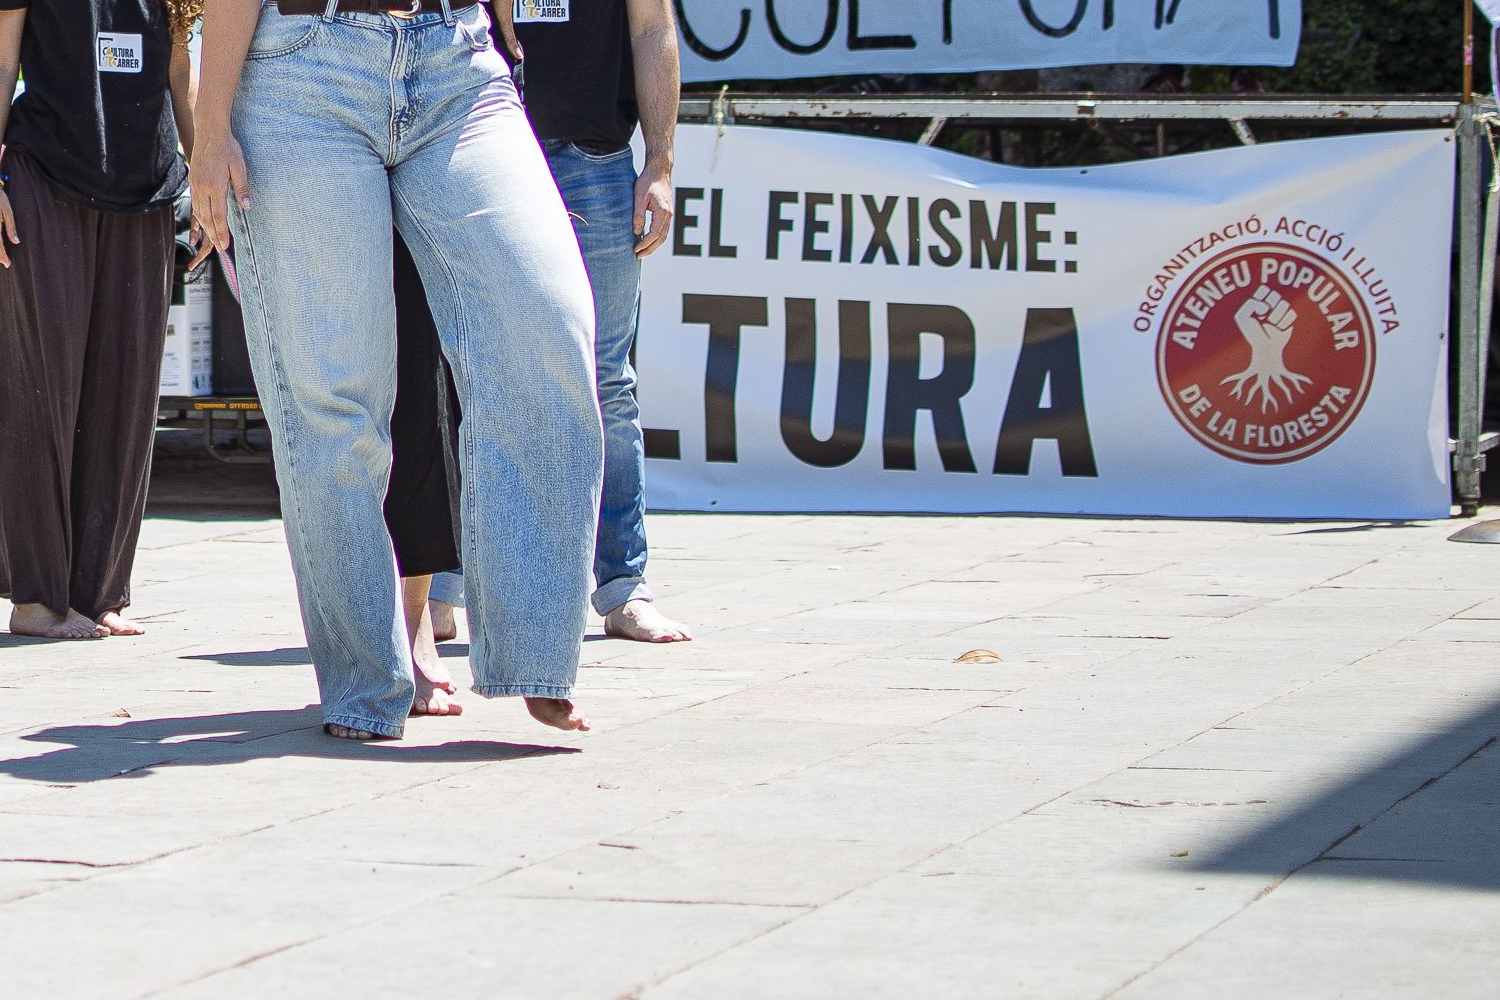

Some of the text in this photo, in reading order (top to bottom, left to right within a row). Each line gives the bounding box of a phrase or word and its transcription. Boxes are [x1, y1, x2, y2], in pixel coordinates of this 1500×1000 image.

[102, 47, 135, 58] CULTURA
[672, 187, 1078, 273] EL FEIXISME:
[1133, 214, 1401, 336] ORGANITZACIÓ, ACCIÓ I LLUITA
[1172, 257, 1360, 351] ATENEU POPULAR
[1179, 383, 1352, 449] DE LA FLORESTA
